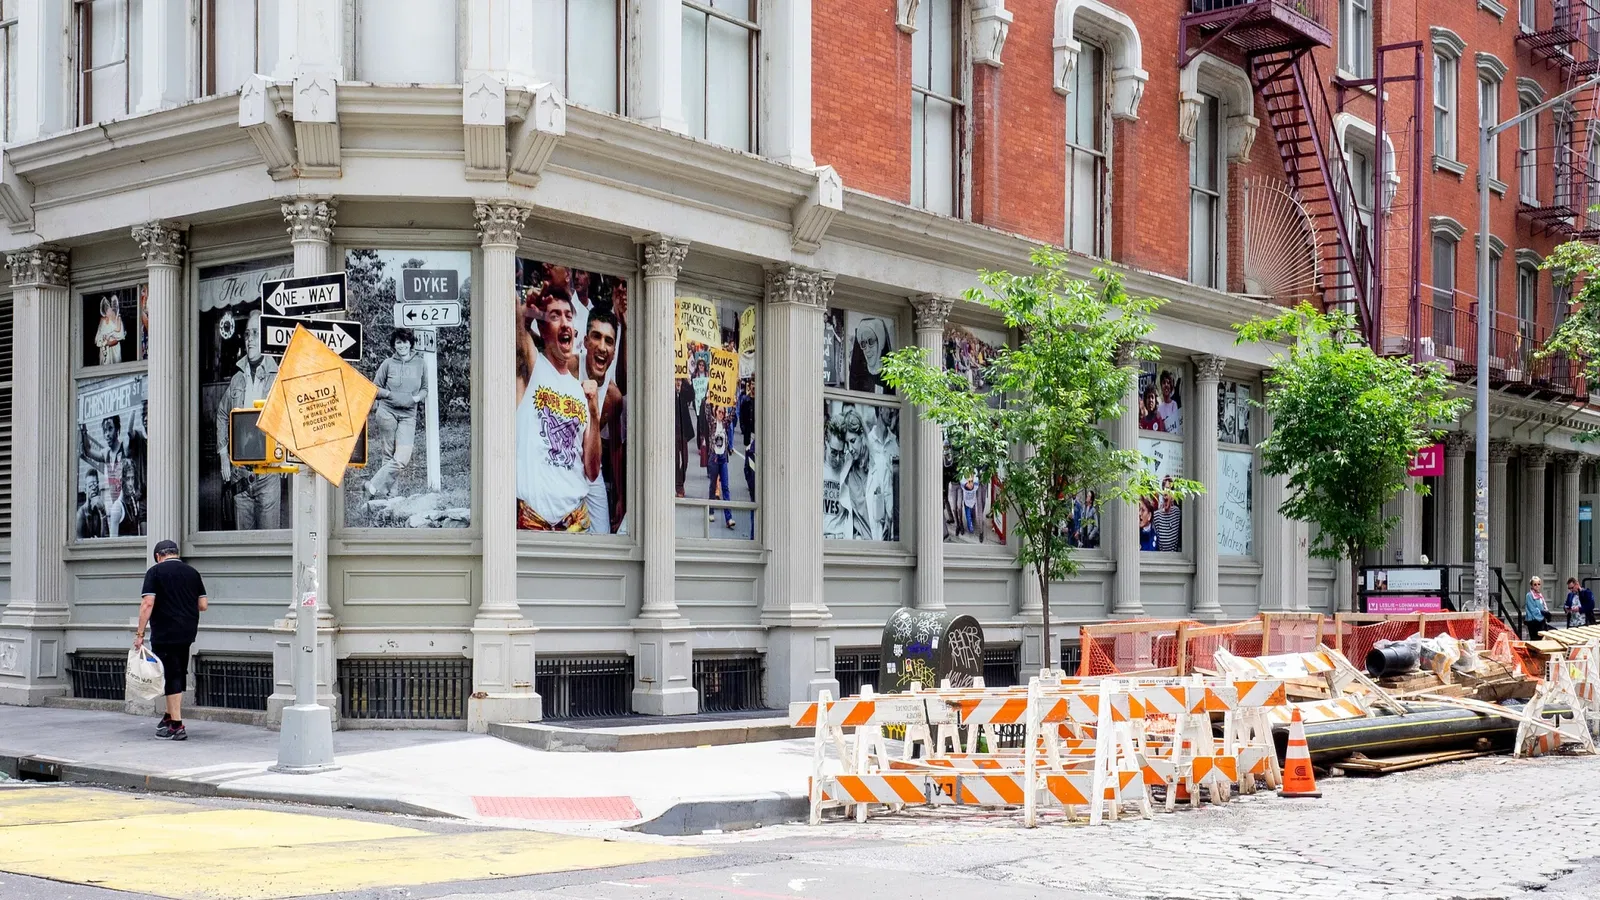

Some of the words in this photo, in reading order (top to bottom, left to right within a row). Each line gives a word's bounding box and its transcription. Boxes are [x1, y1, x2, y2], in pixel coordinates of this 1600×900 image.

[414, 277, 448, 293] DYKE
[275, 291, 297, 307] ONE
[309, 286, 334, 303] WAY
[421, 308, 449, 320] 627
[692, 304, 712, 316] POLICE
[275, 329, 294, 343] ON
[317, 332, 346, 347] WAY
[710, 351, 735, 371] YOUNG,
[709, 368, 727, 384] GAY,
[712, 383, 727, 393] AND
[84, 385, 131, 419] CHRISTOPHER
[709, 390, 731, 404] PROUD
[324, 405, 337, 414] LANE
[303, 416, 328, 427] PROCEED
[329, 412, 342, 420] WITH
[313, 422, 336, 432] CAUTION
